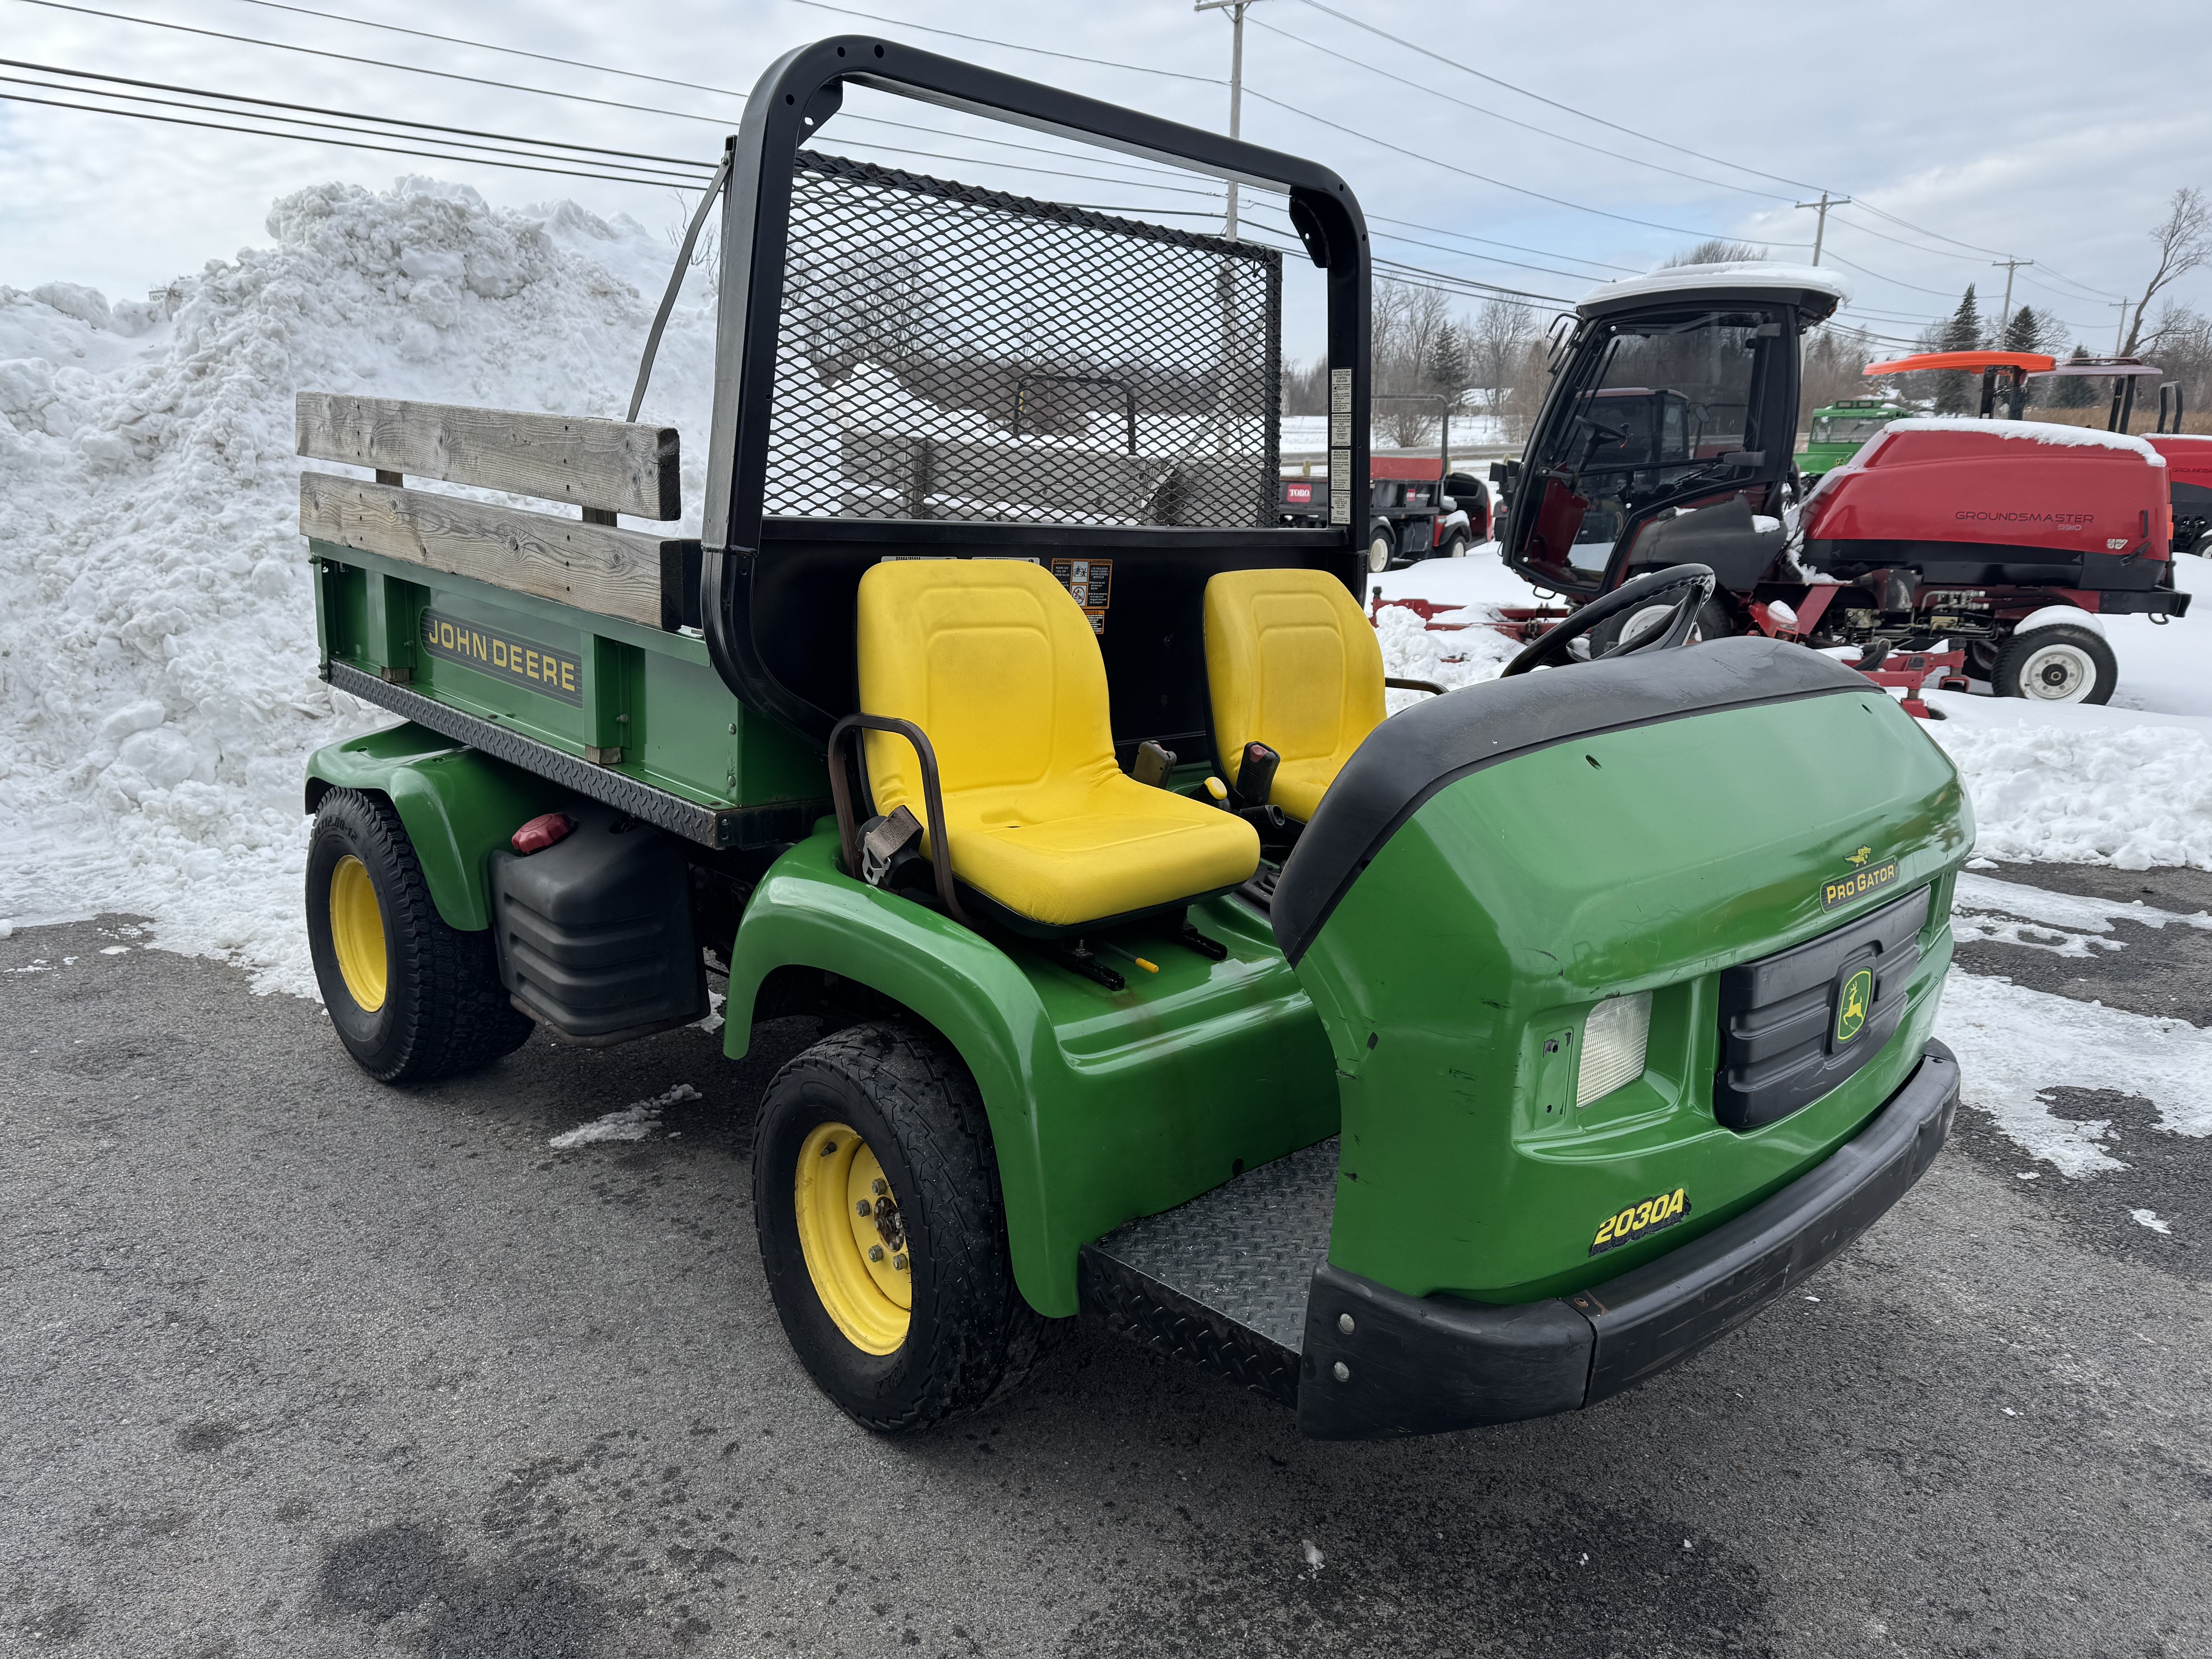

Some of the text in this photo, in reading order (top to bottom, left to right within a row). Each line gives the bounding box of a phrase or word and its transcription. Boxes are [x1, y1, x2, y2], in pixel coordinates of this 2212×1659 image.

[1290, 489, 1310, 497] TORO
[1955, 511, 2094, 523] GROUNDSMASTER
[429, 620, 575, 692] JOHN DEERE
[1827, 864, 1894, 904] PRO GATOR
[1594, 1188, 1684, 1245] 2030A
